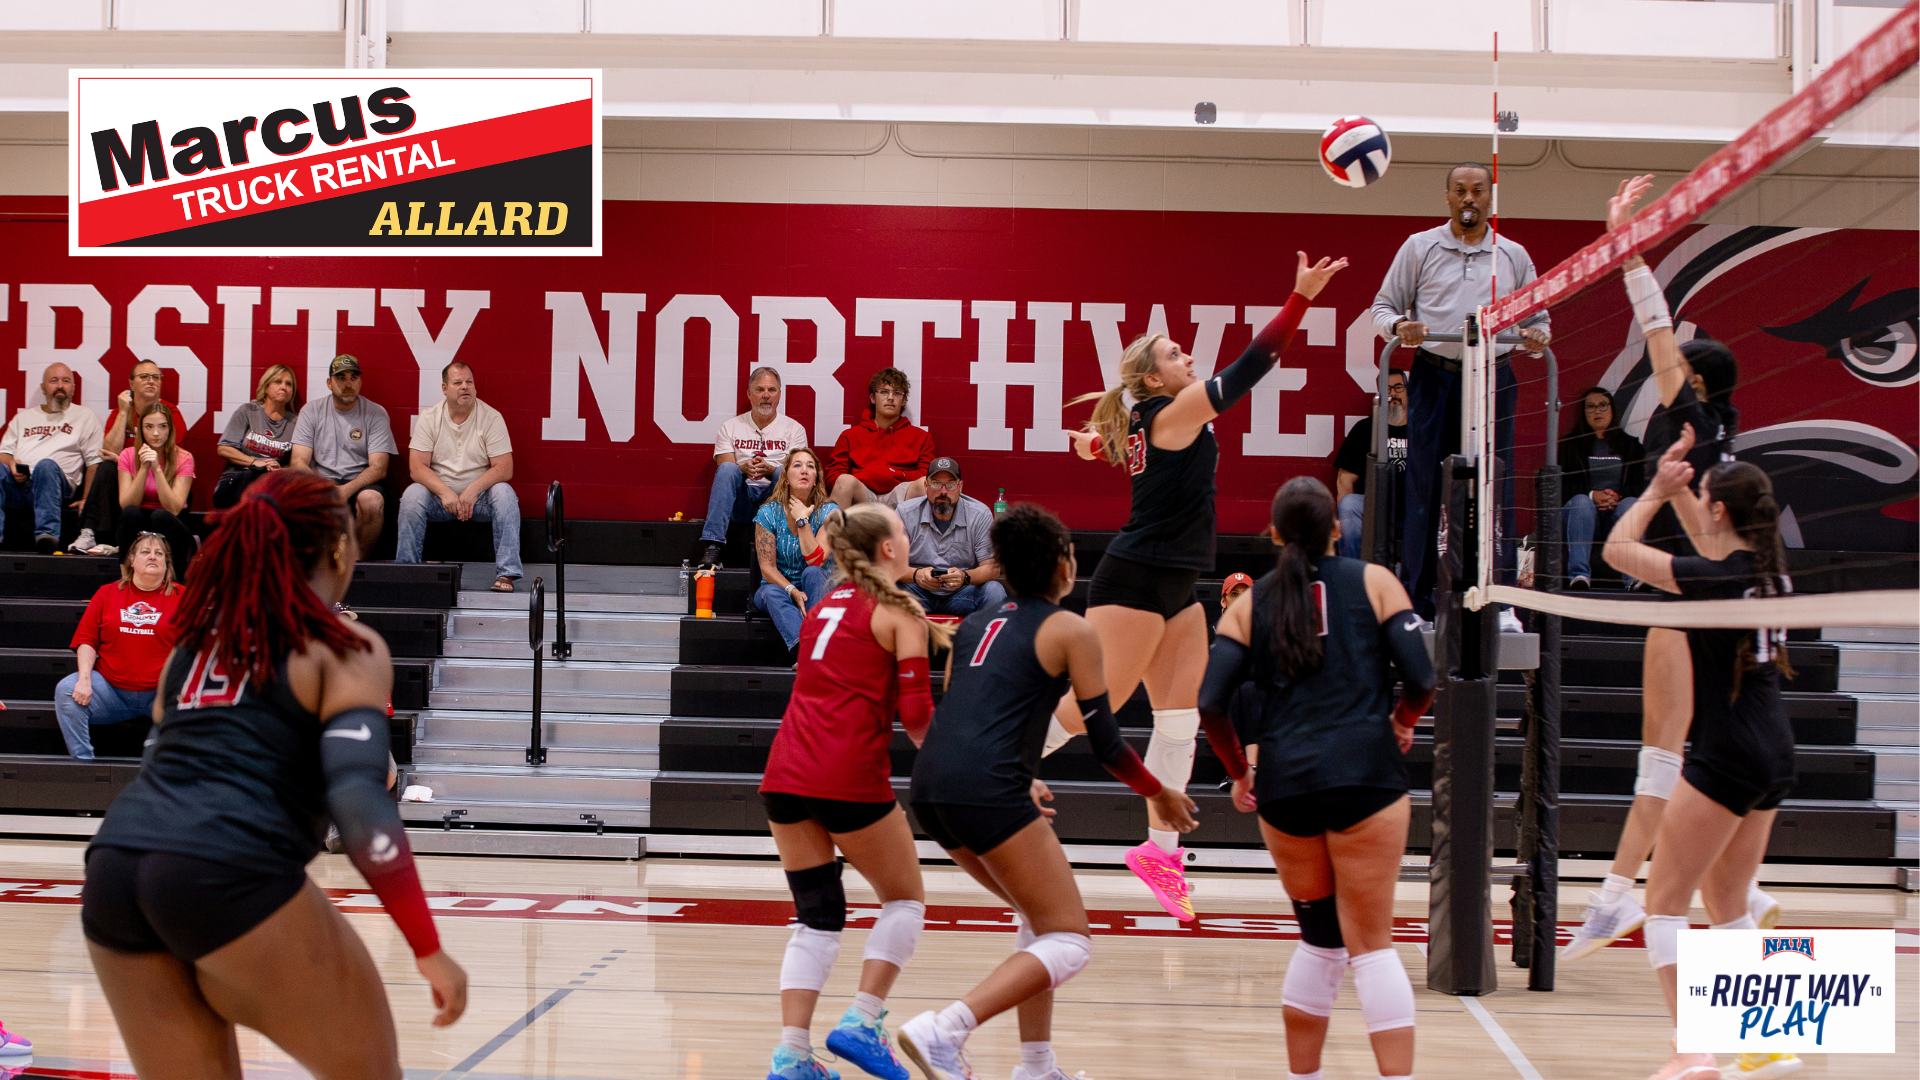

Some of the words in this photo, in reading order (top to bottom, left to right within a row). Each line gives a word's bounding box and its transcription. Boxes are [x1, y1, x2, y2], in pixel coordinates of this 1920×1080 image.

[0, 283, 490, 437] RSITY
[23, 422, 73, 438] REDHAKS
[734, 439, 787, 451] REDHAWKS
[119, 627, 155, 636] VOLLEYBALL
[810, 606, 847, 661] 7
[969, 617, 1009, 667] 1
